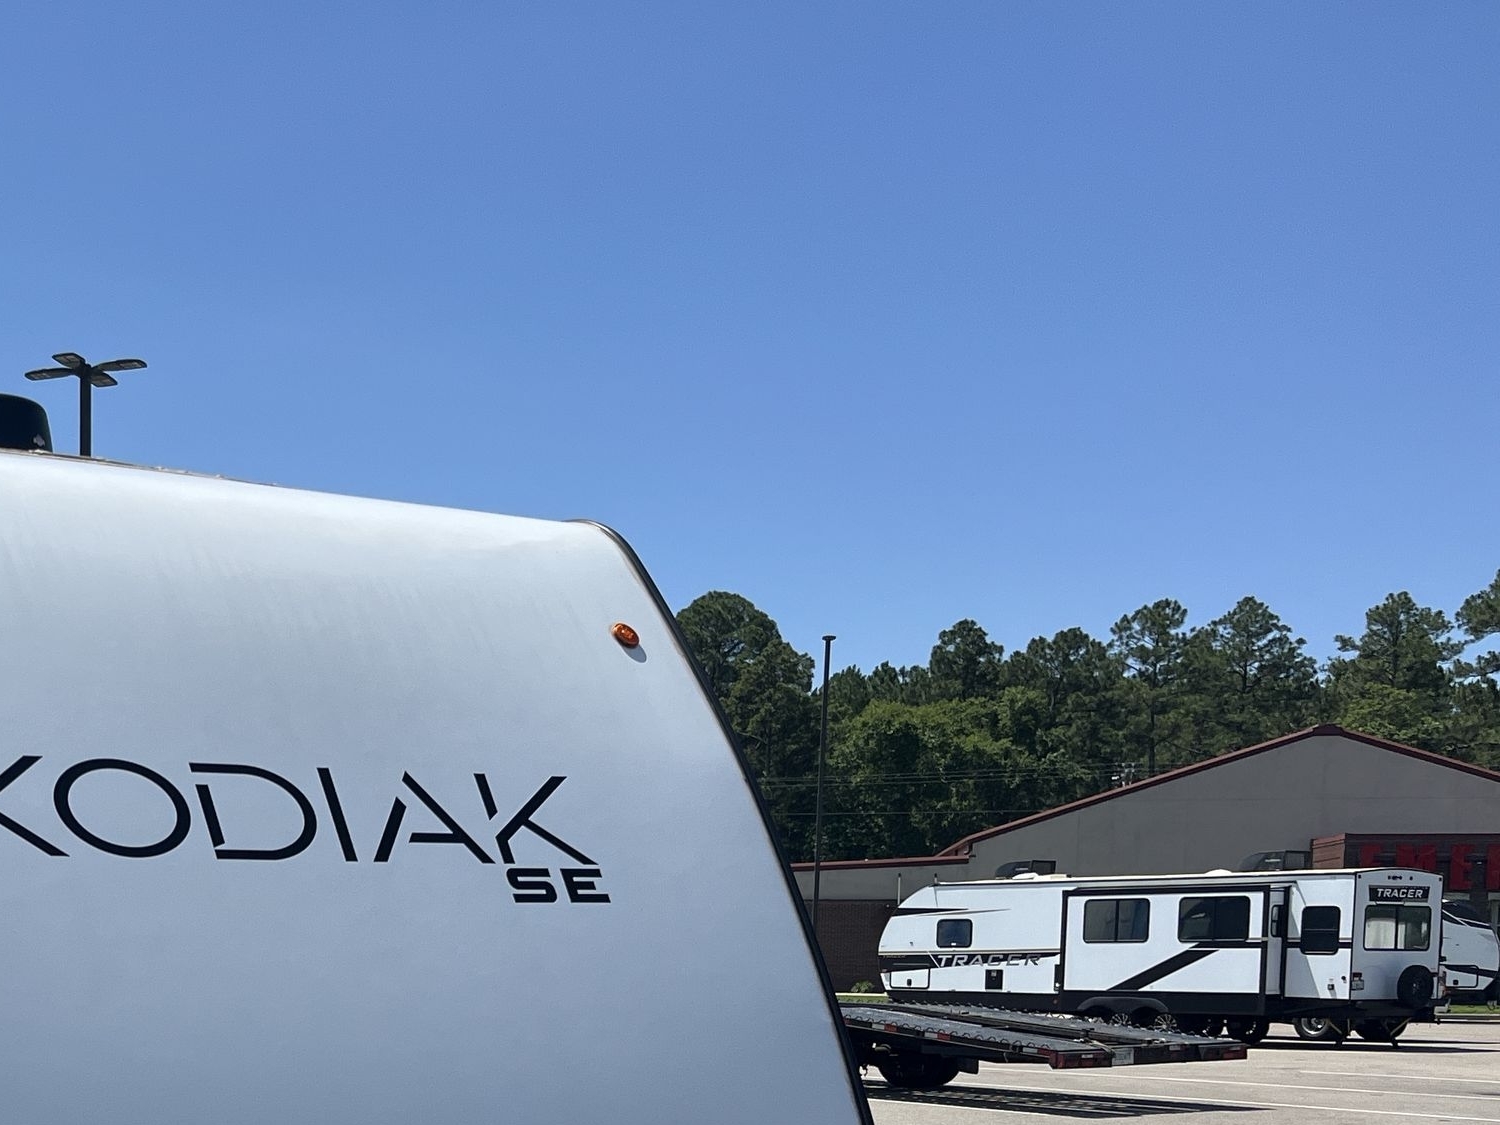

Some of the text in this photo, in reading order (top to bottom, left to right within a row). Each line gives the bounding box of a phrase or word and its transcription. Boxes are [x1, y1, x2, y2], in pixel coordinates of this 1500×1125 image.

[505, 867, 611, 903] SE
[1376, 888, 1424, 899] TRACER
[937, 953, 1042, 967] TRACER
